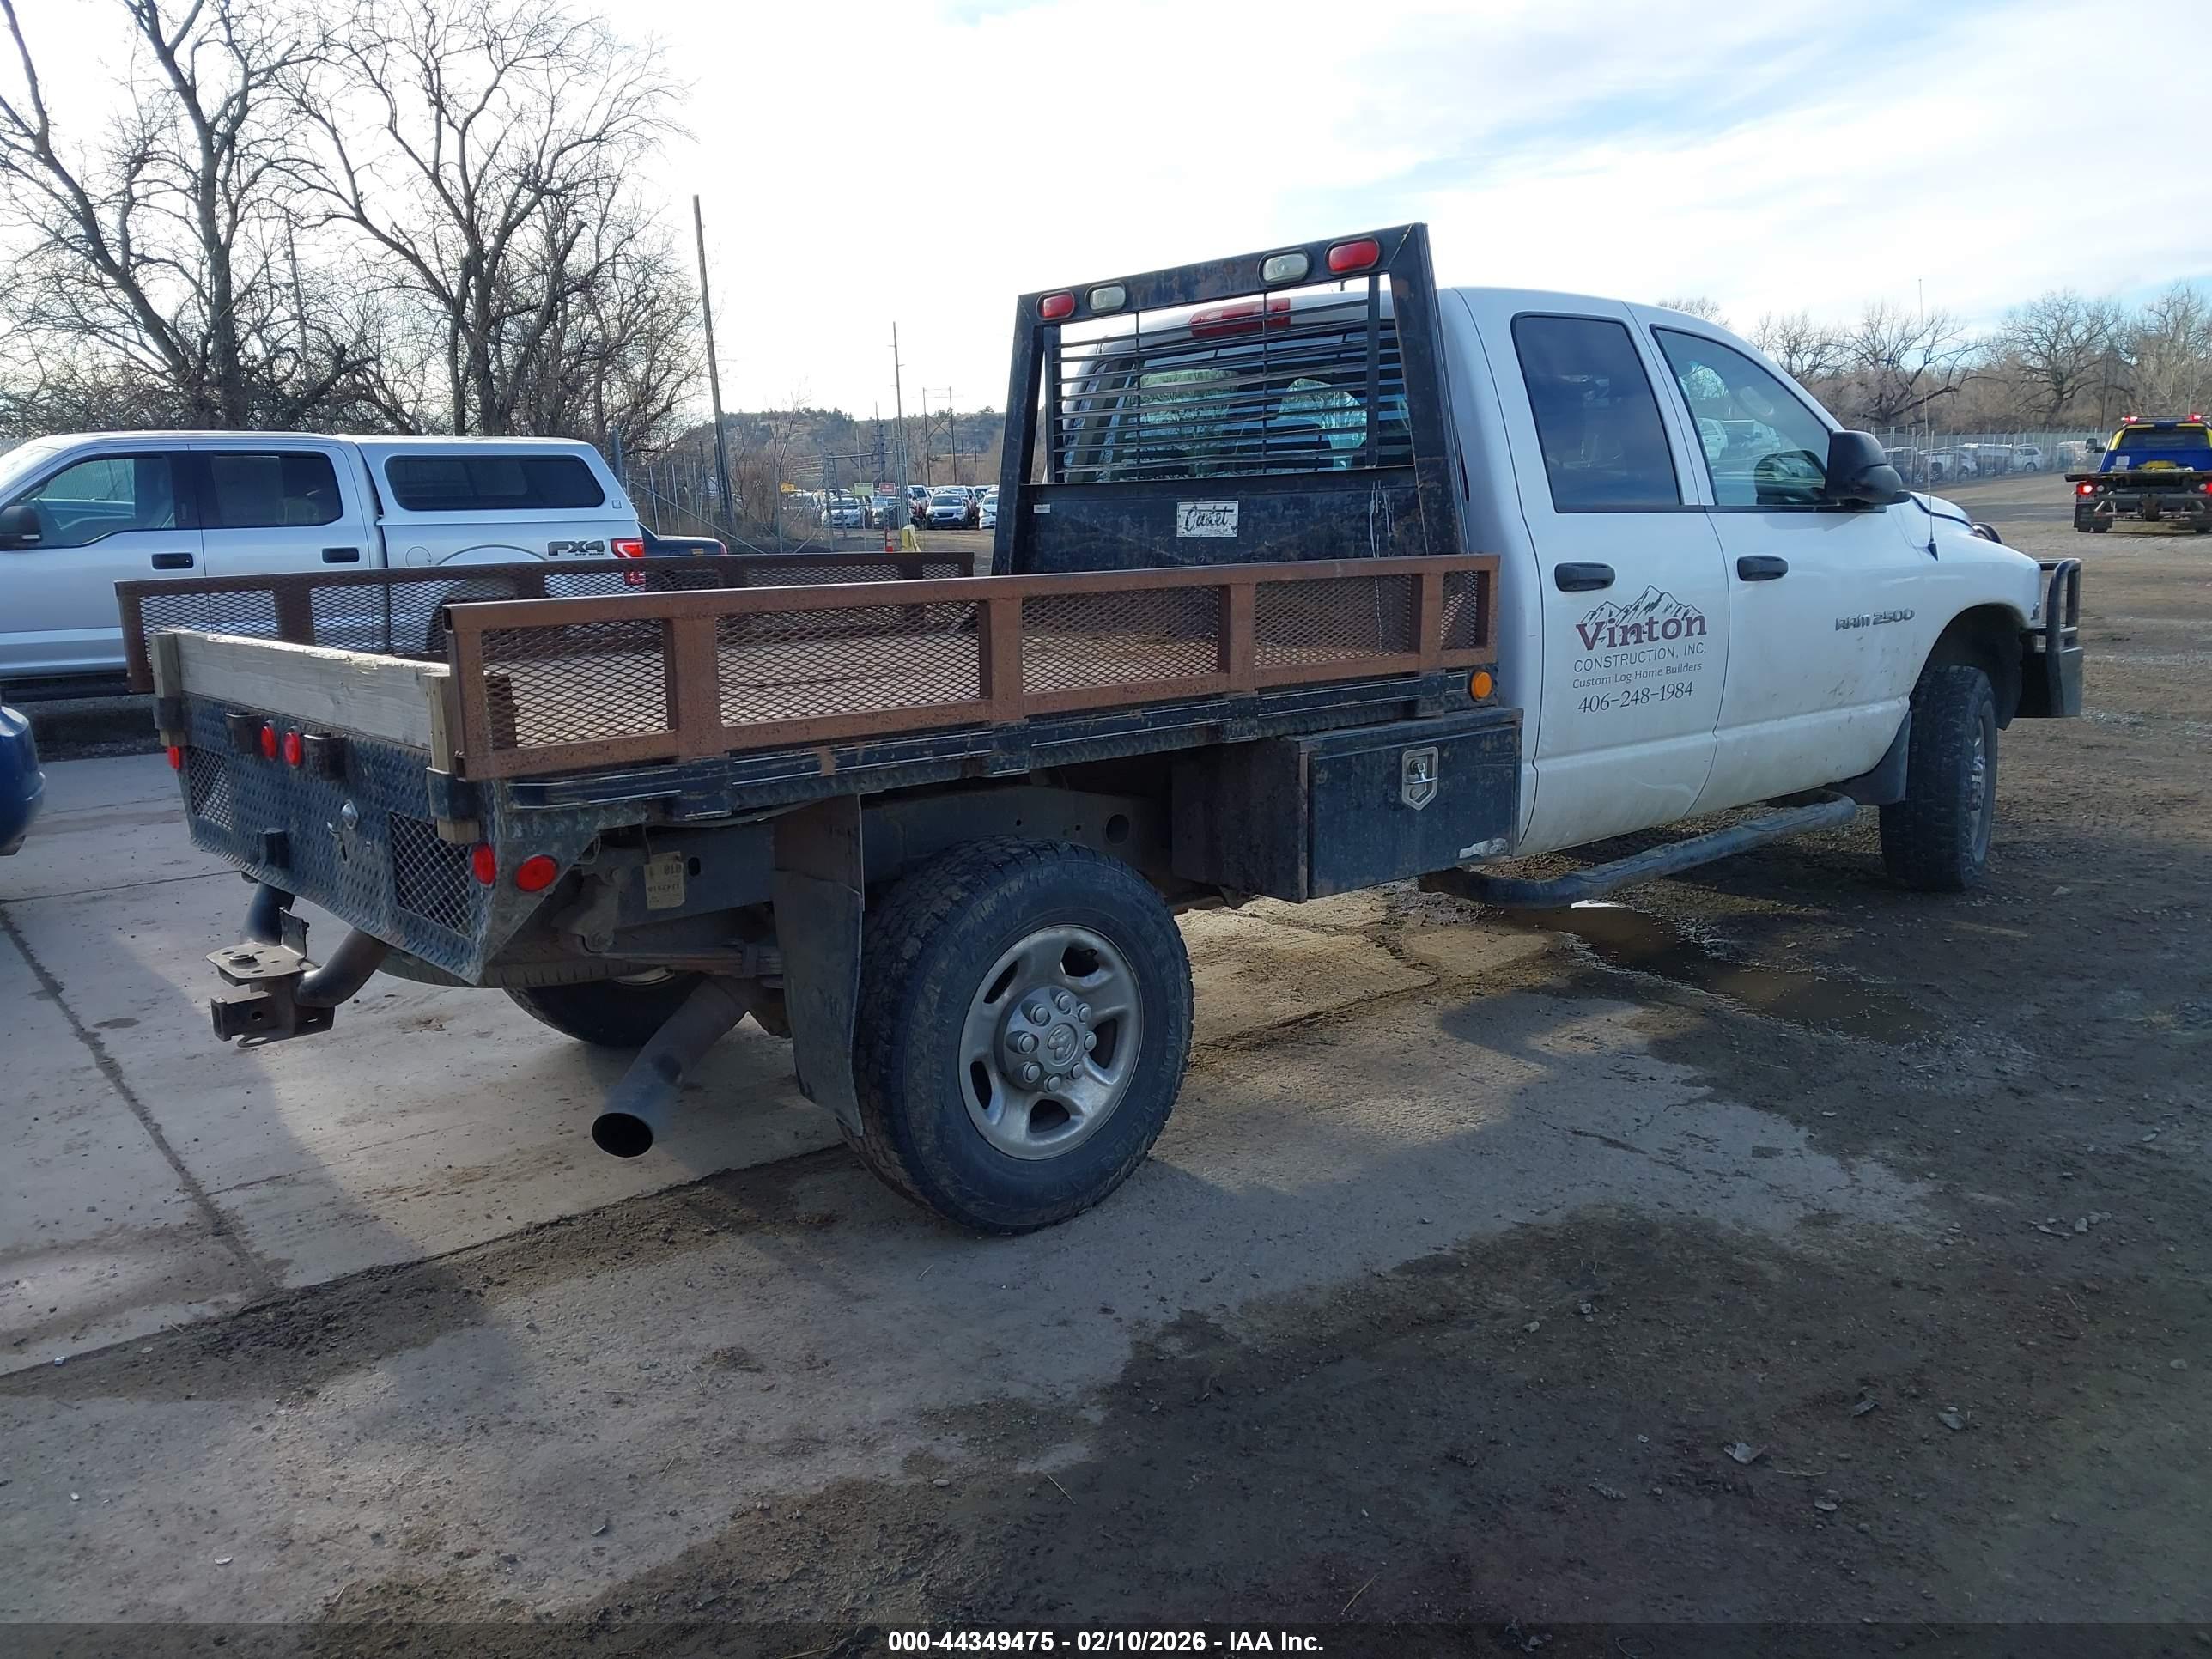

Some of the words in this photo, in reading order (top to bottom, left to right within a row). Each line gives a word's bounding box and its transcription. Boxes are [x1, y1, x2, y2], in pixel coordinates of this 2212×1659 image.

[548, 540, 605, 556] FX4
[1873, 608, 1915, 625] 2500
[1576, 615, 1707, 651] Vinton
[1574, 647, 1679, 672] CONSTRUCTION,
[1684, 642, 1706, 658] INC.
[1573, 675, 1611, 689] Custom
[1614, 672, 1632, 684] Log
[1634, 667, 1662, 679] Home
[1665, 662, 1702, 675] Builders
[1577, 681, 1694, 714] 406-248-1984
